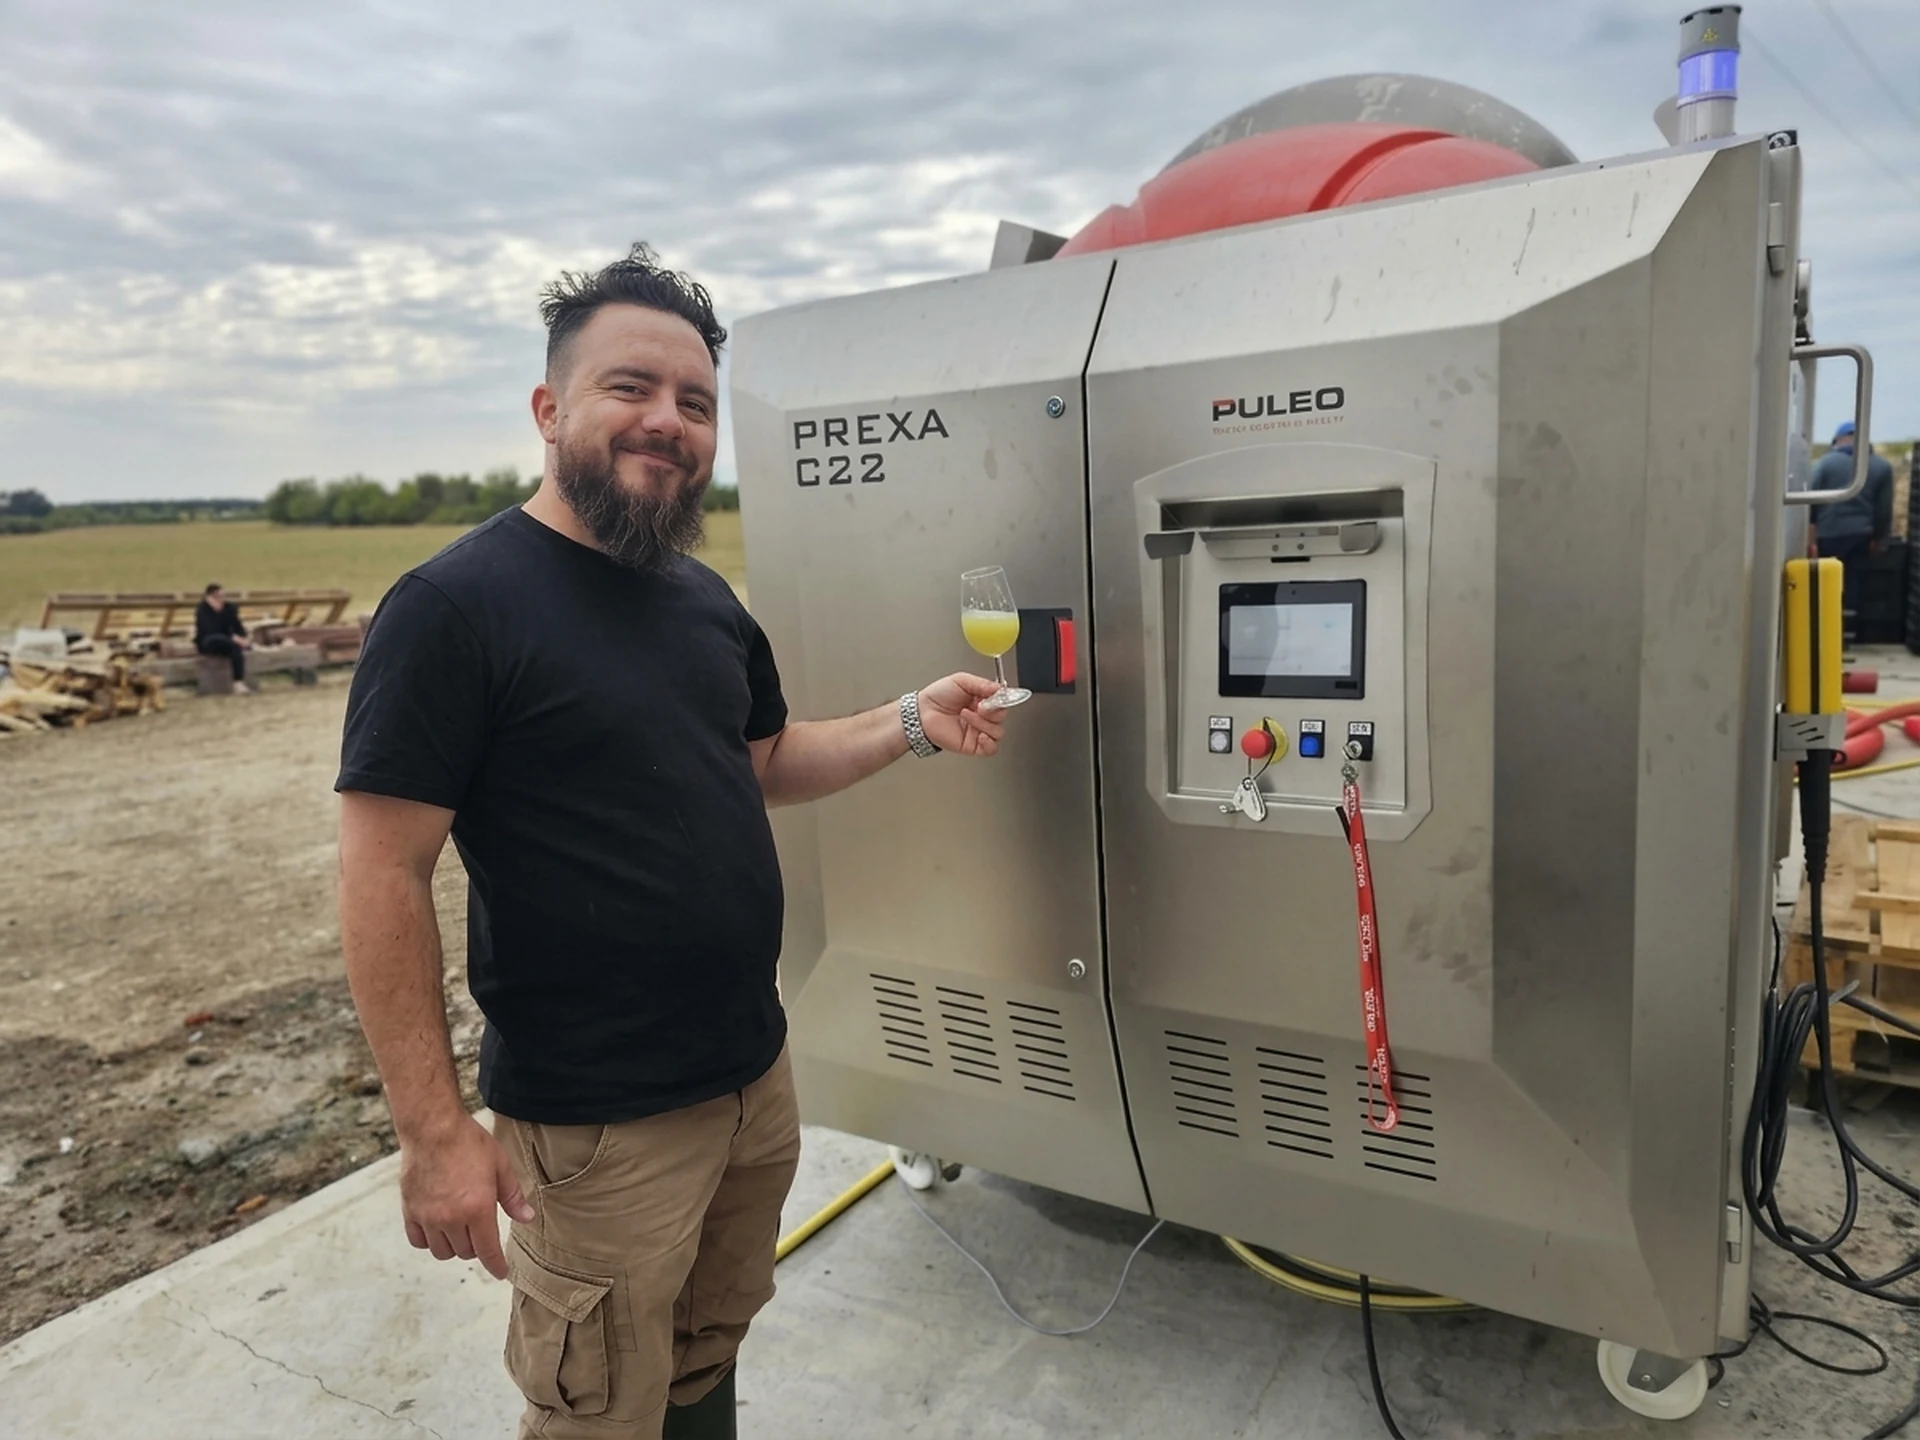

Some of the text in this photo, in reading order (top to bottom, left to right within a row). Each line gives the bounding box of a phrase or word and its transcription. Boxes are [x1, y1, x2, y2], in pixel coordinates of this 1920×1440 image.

[1212, 386, 1345, 422] PULEO
[793, 408, 950, 450] PREXA
[796, 453, 886, 487] C22
